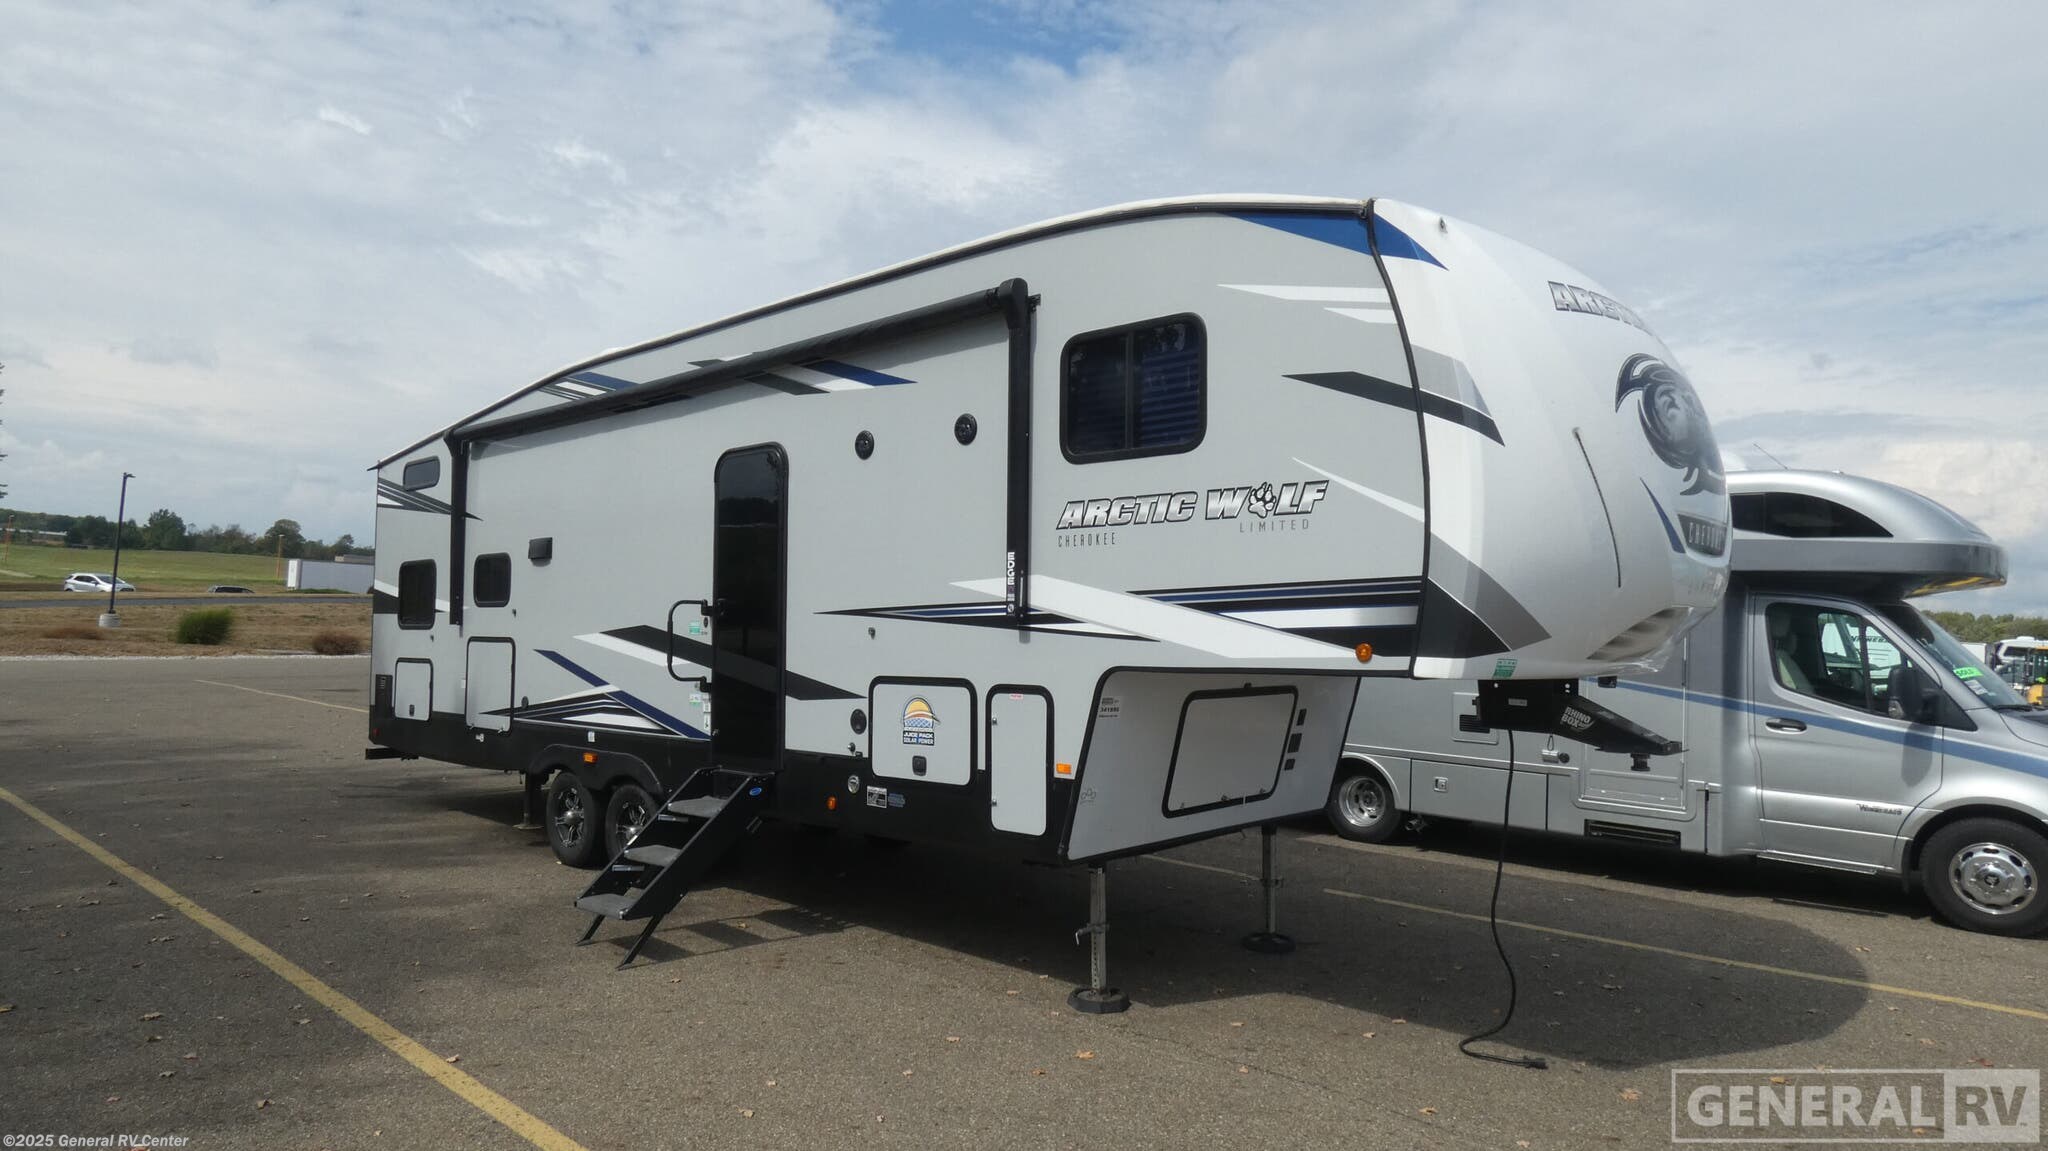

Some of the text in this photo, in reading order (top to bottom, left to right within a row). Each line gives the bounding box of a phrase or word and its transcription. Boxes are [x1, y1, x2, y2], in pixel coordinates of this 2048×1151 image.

[1056, 491, 1198, 530] ARCTIC
[1239, 518, 1310, 533] LIMITED
[1058, 532, 1117, 548] CHEROKEE
[1007, 551, 1016, 586] EDGE
[1561, 713, 1578, 728] BOX
[1564, 706, 1591, 724] RHINO
